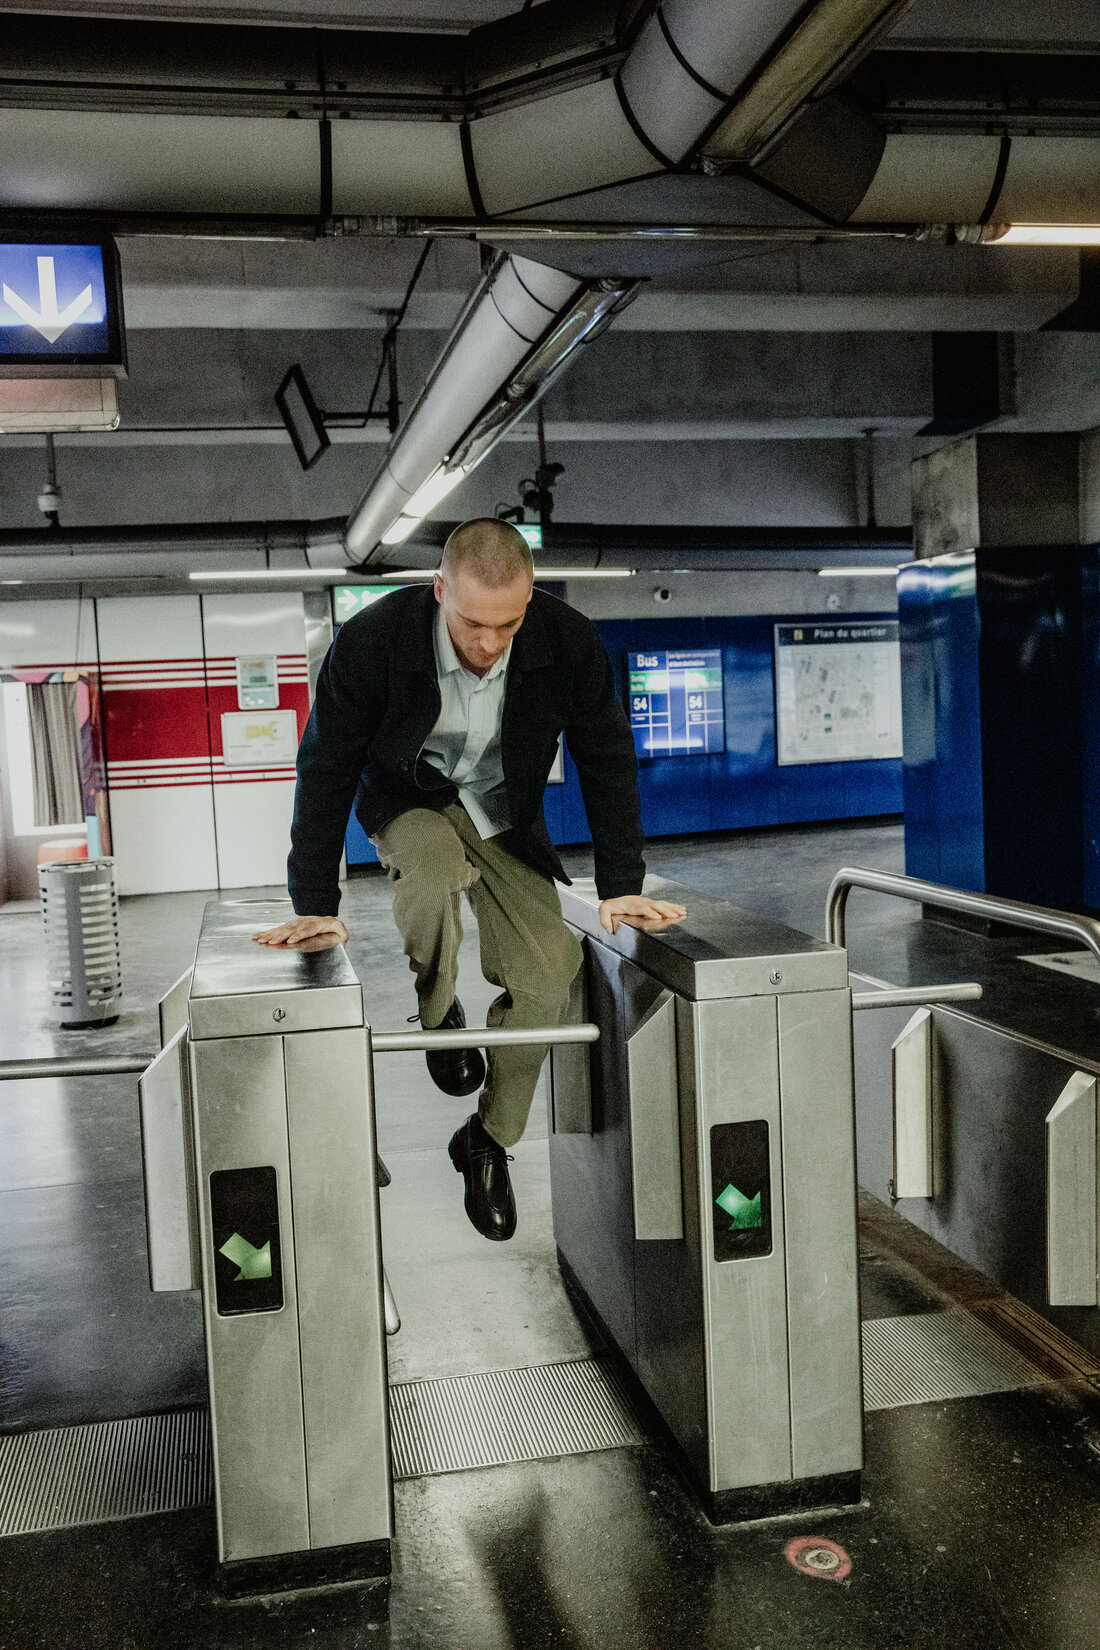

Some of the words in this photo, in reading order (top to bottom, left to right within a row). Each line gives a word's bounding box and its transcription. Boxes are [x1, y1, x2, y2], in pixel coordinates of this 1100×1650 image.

[813, 629, 834, 638] Plan
[836, 628, 849, 638] du
[850, 627, 886, 639] quartier
[636, 654, 659, 668] Bus
[633, 697, 648, 711] 54
[688, 695, 703, 709] 54
